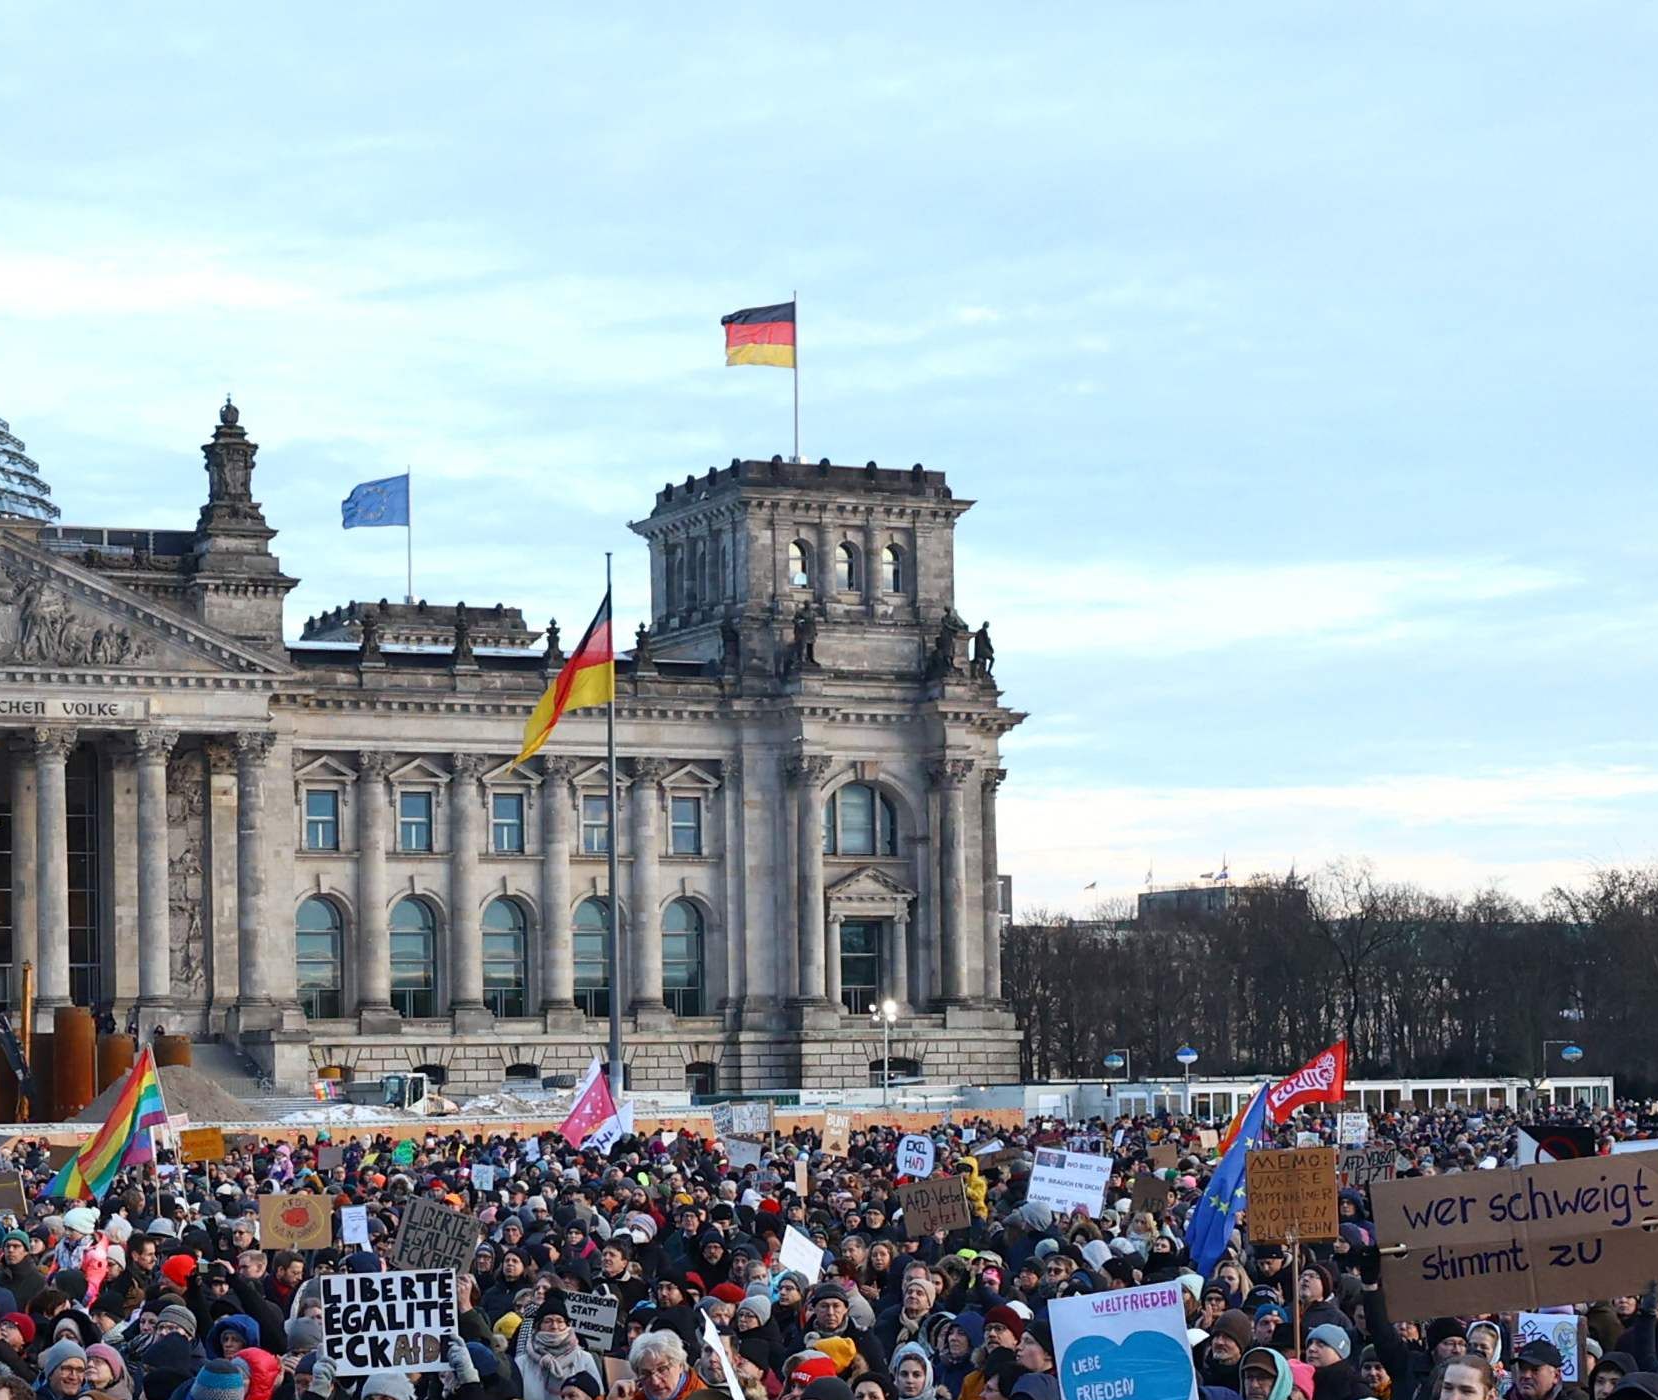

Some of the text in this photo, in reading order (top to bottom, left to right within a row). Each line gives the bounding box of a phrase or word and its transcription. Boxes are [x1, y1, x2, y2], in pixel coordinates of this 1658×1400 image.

[63, 702, 118, 717] VOLKE
[1251, 1154, 1329, 1170] MEMO:
[1250, 1172, 1322, 1189] UNSERE
[1402, 1168, 1654, 1229] wer schweigt
[1254, 1206, 1327, 1222] WOLLEN
[1421, 1239, 1530, 1281] stimmt
[322, 1268, 454, 1305] LIBERTÉ
[570, 1304, 599, 1317] STATT
[1091, 1289, 1178, 1315] WELTFRIEDEN
[325, 1298, 455, 1336] ÉGALITÉ
[1072, 1355, 1102, 1376] LIEBE
